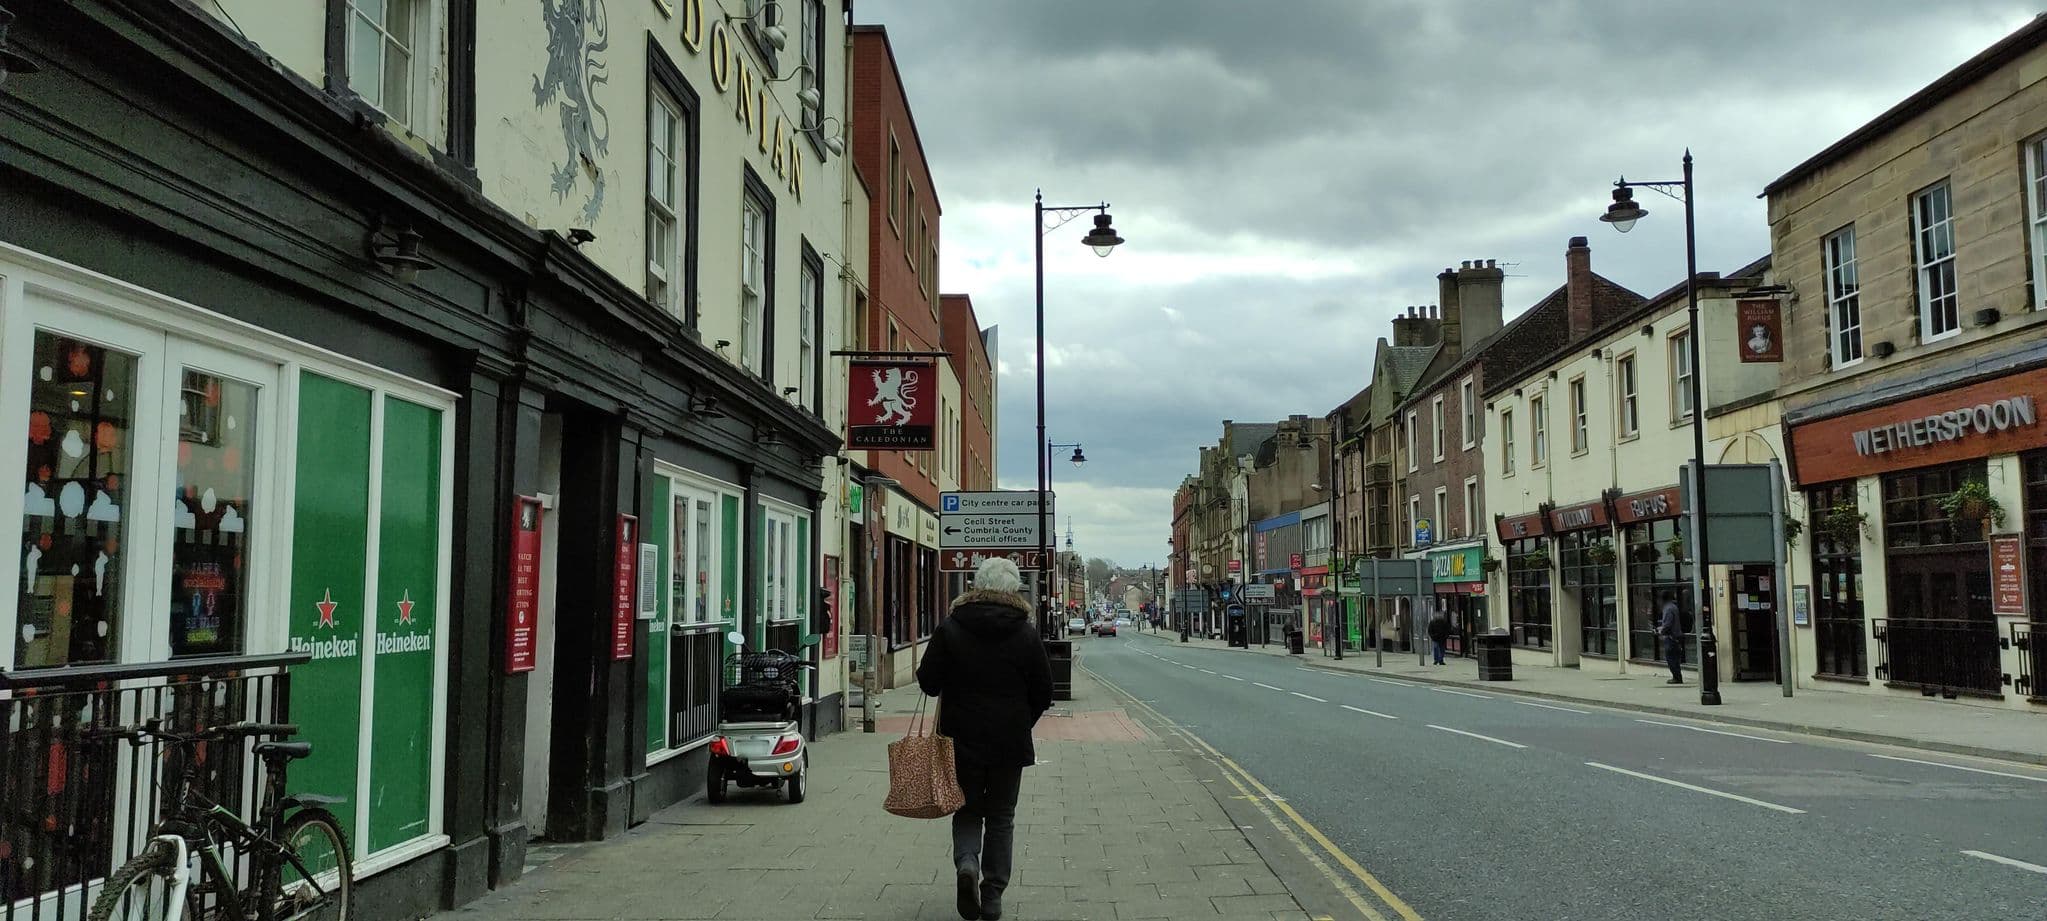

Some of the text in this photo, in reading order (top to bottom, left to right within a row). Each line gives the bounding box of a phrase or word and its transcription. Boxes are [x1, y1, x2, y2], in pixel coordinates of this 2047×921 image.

[656, 0, 803, 205] DONIAN
[1852, 395, 2035, 457] WETHERSPOON
[961, 499, 979, 508] City
[1027, 500, 1051, 508] pas
[1510, 521, 1527, 537] THE
[1631, 494, 1668, 519] RUFUS
[1002, 527, 1033, 535] County
[1451, 552, 1465, 577] TIME
[376, 631, 431, 655] Heineken
